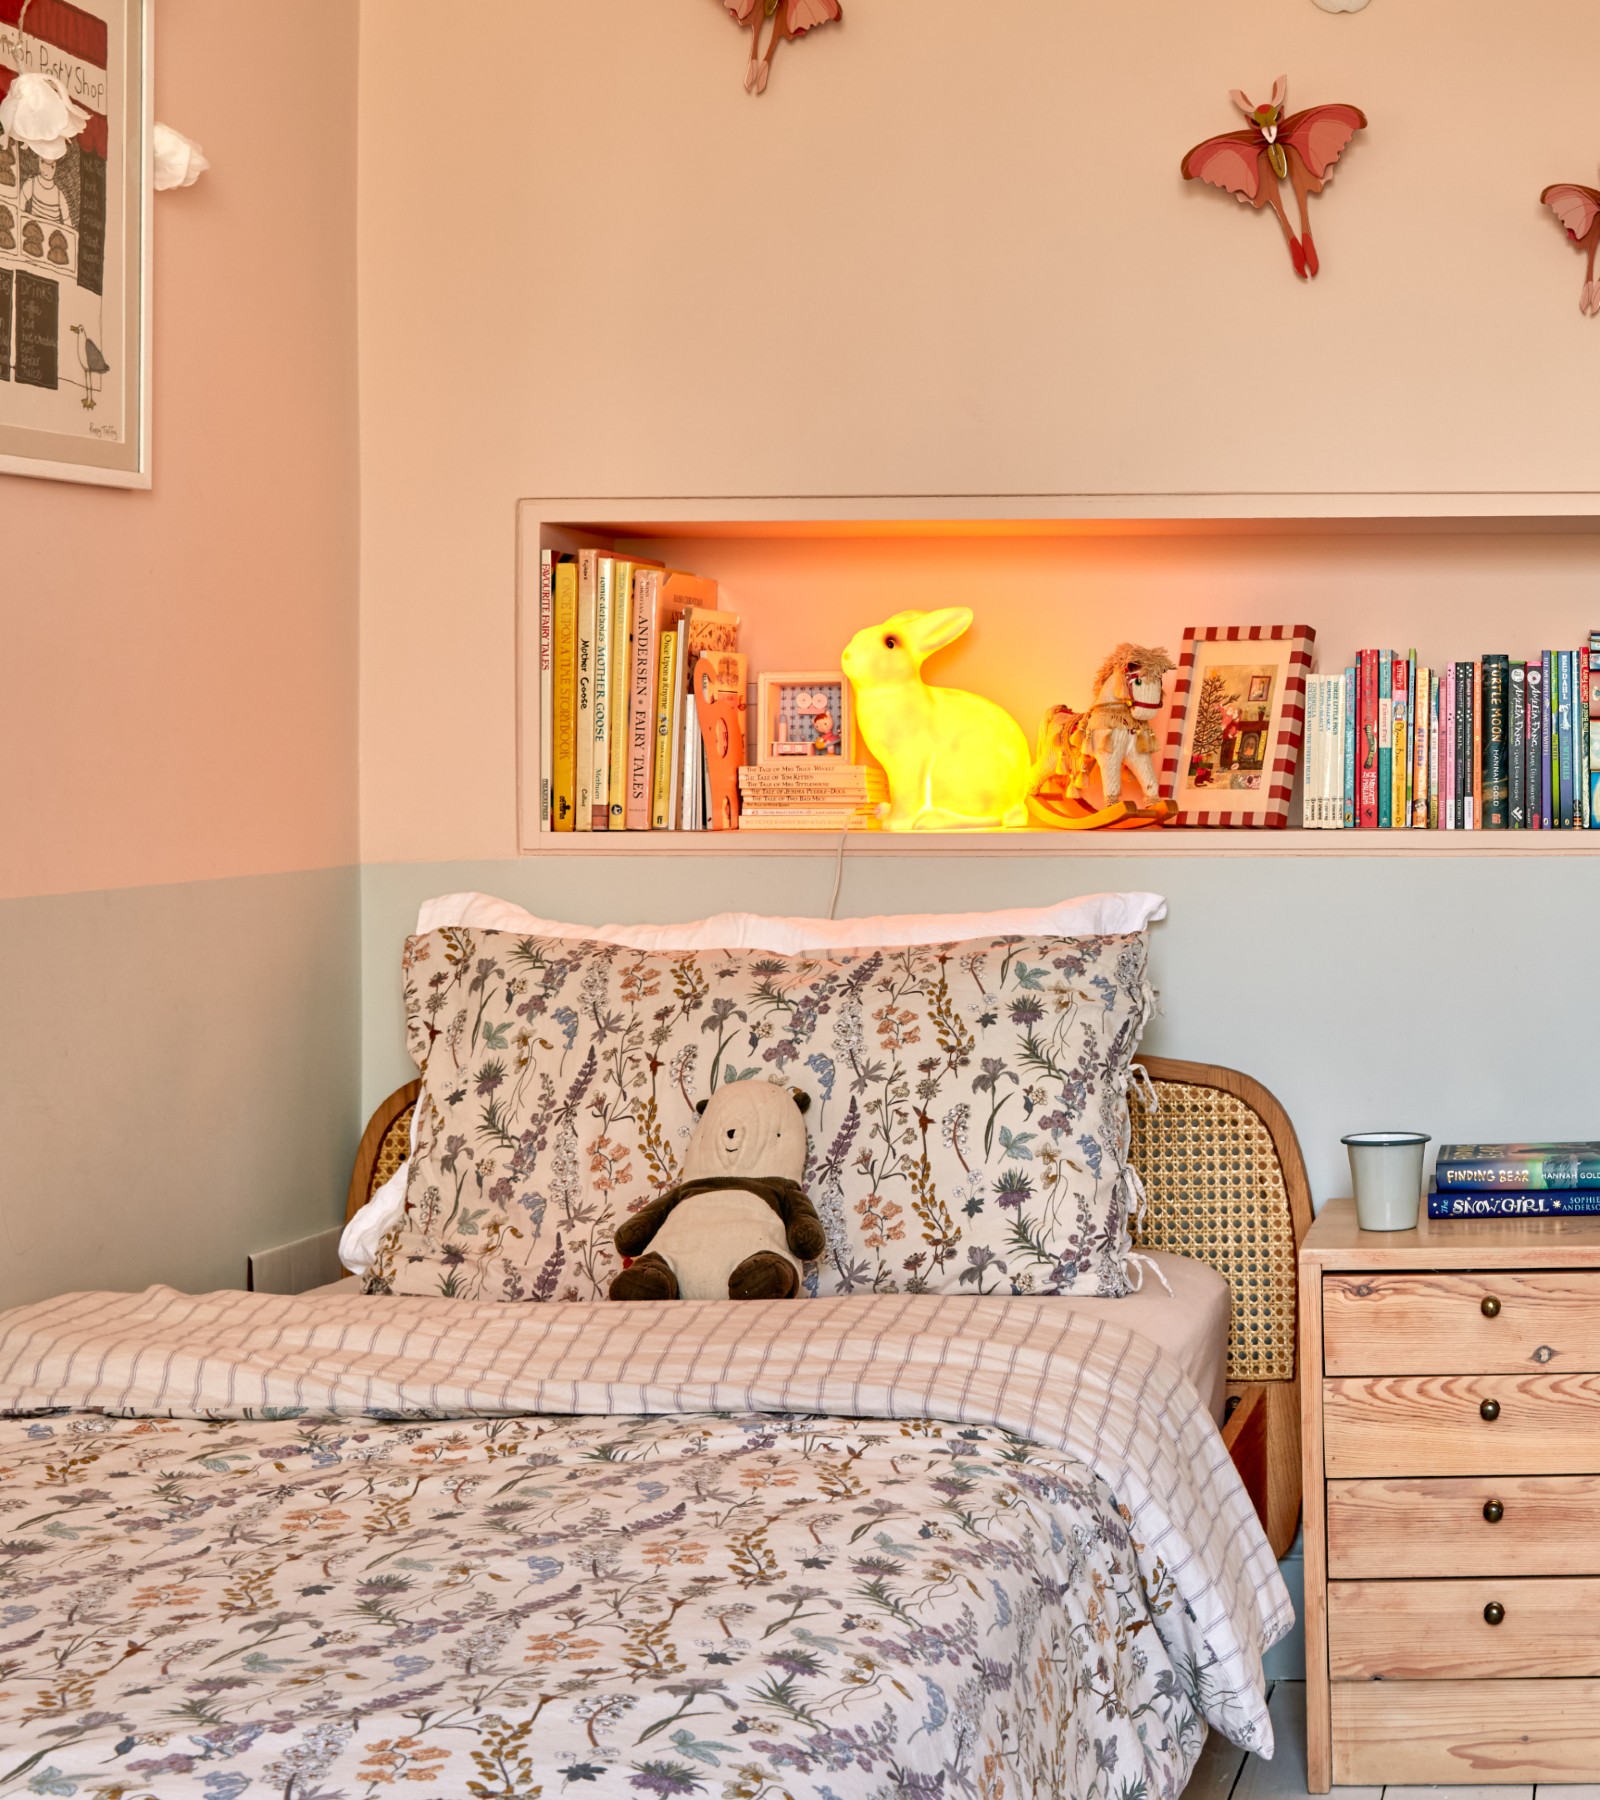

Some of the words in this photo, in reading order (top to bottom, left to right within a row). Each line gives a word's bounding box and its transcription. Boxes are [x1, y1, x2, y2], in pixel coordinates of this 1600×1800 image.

[75, 67, 104, 108] Shop
[542, 563, 550, 613] FAVOURITE
[560, 577, 571, 610] ONCE
[542, 614, 550, 640] FAIRY
[560, 612, 571, 644] UPON
[661, 634, 671, 654] Once
[542, 642, 550, 671] TALES
[560, 646, 570, 655] A
[580, 638, 590, 672] Mother
[636, 614, 648, 696] ANDERSEN
[661, 656, 671, 674] Upon
[560, 656, 570, 686] TIME
[596, 645, 606, 699] MOTHER
[1491, 663, 1502, 704] TURTLE
[580, 676, 590, 710] Goose
[660, 682, 670, 710] Rhyme
[1513, 684, 1524, 718] AMELIA
[1530, 685, 1541, 720] AMELIA
[560, 688, 570, 760] STORYBOOK
[596, 702, 605, 742] GOOSE
[634, 710, 646, 750] FAIRY
[1491, 708, 1502, 743] MOON
[1514, 721, 1522, 747] FANG
[1531, 721, 1541, 747] FANG
[633, 754, 645, 799] TALES
[1446, 1170, 1496, 1184] FINDING
[1499, 1170, 1530, 1183] BEAR
